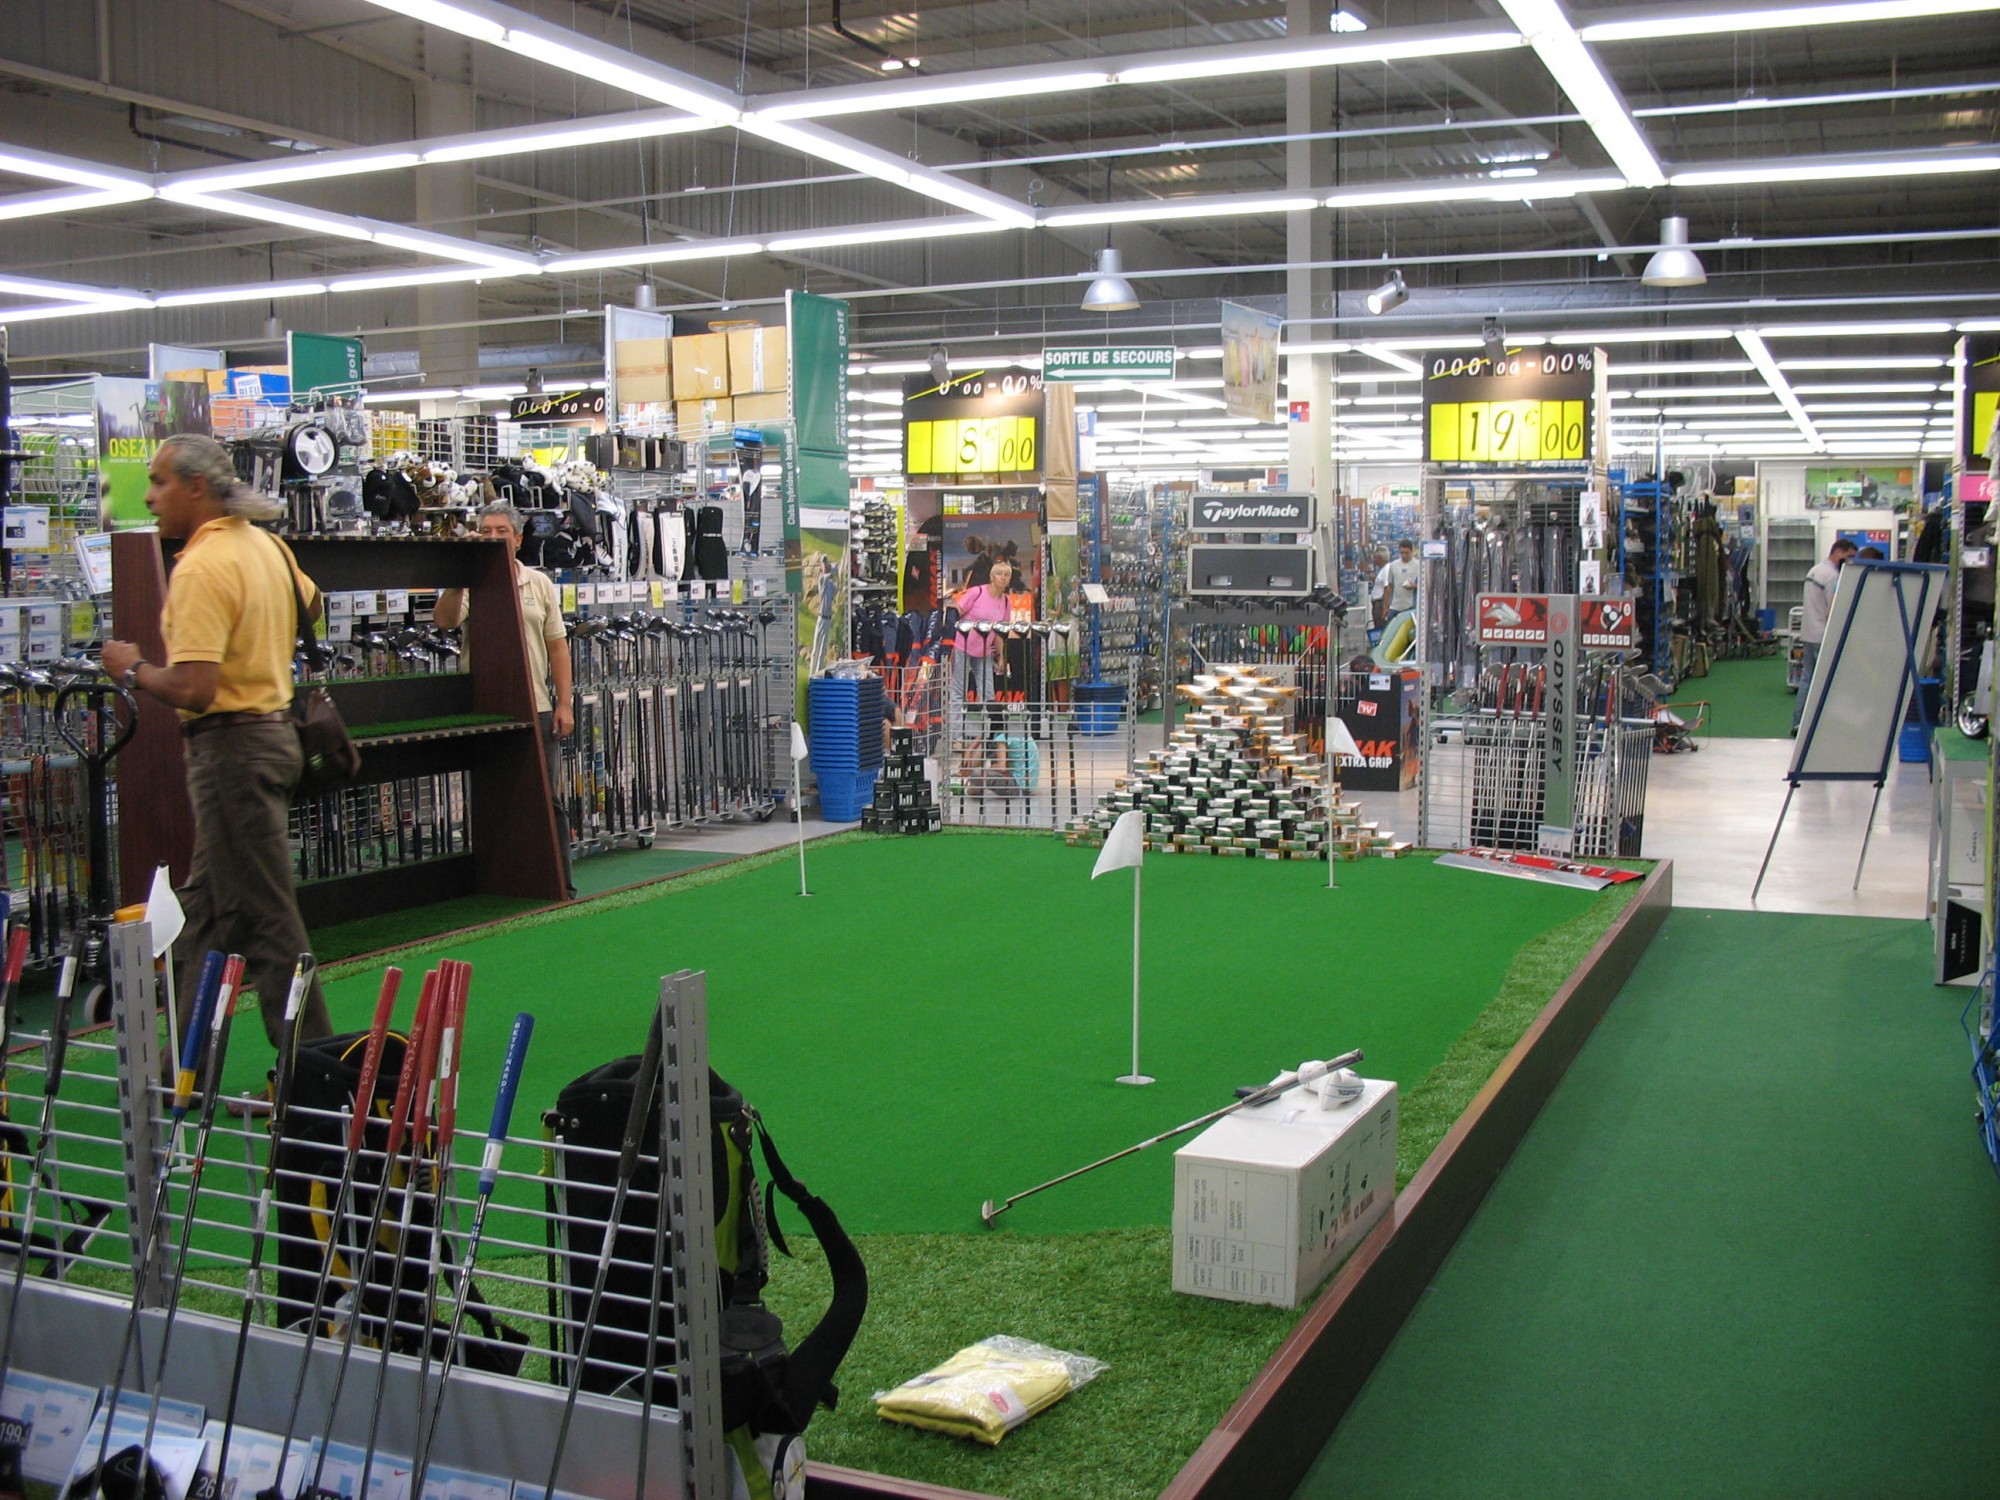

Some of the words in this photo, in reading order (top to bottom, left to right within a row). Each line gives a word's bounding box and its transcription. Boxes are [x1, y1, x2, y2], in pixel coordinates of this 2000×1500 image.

[836, 309, 847, 347] golf
[347, 346, 358, 380] golf
[1045, 351, 1090, 365] SORTIE
[1092, 351, 1110, 365] DE
[1112, 350, 1173, 365] SECOURS
[109, 438, 147, 458] OSEZ
[786, 500, 796, 526] Clubs
[1202, 500, 1300, 523] TaylorMade
[1551, 639, 1565, 773] ODYSSEY
[1335, 755, 1368, 768] EXTRA
[1368, 757, 1393, 769] GRIP
[500, 1021, 521, 1095] BETTINARDI
[1, 1422, 23, 1444] 199
